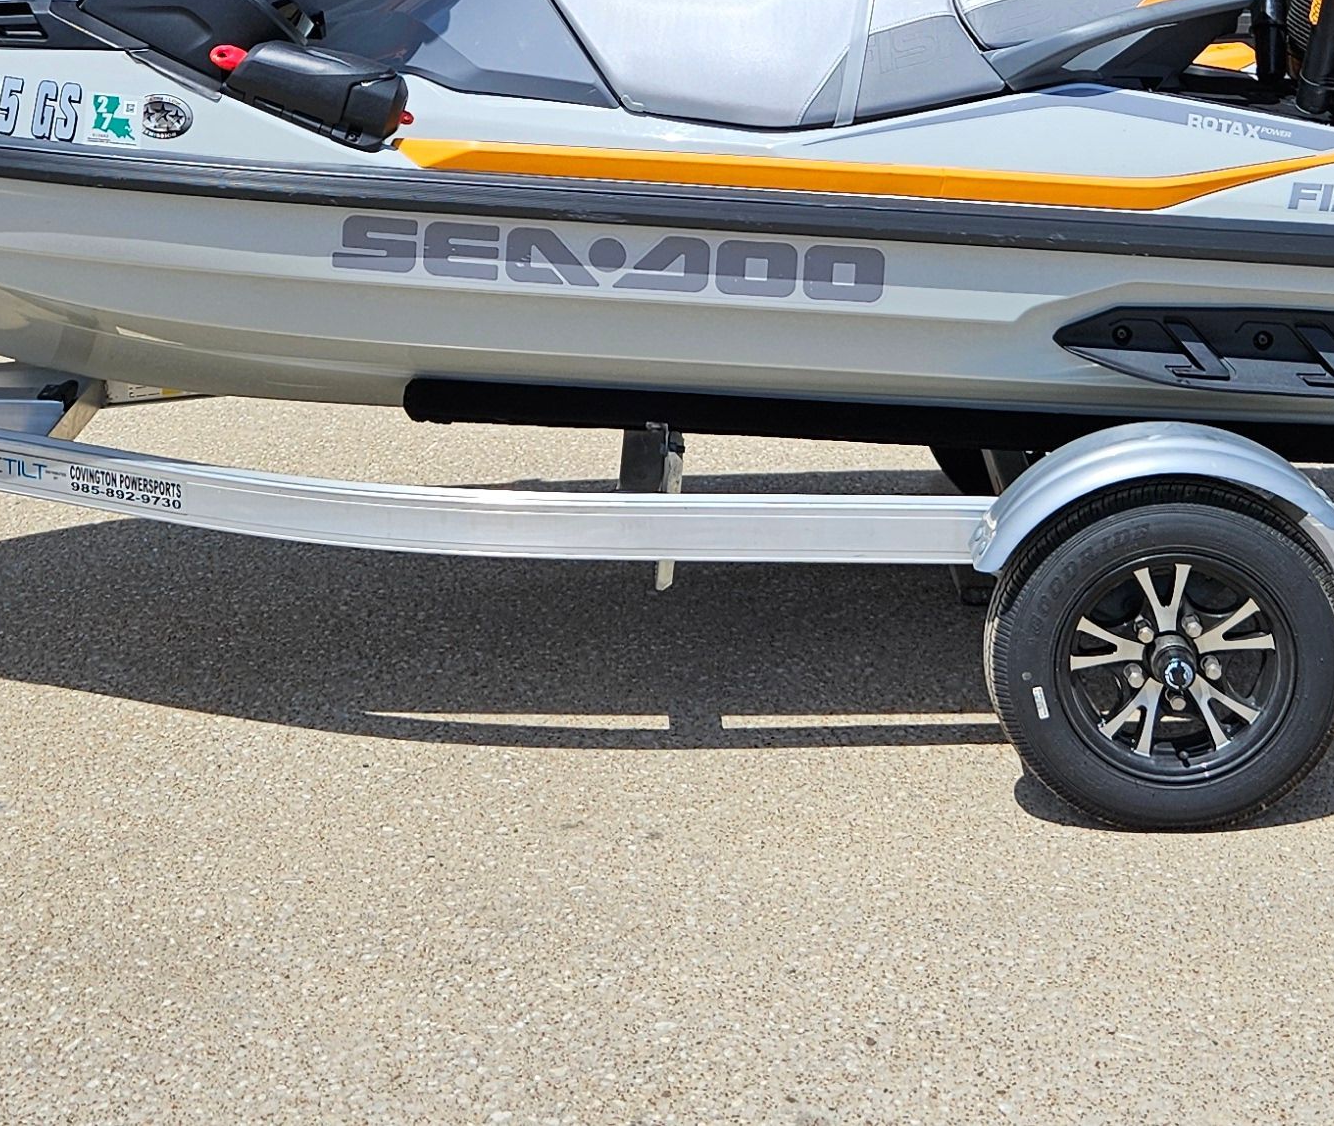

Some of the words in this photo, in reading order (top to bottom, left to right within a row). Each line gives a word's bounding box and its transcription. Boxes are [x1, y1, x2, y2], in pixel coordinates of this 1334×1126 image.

[30, 80, 83, 142] GS
[1188, 113, 1261, 140] ROTAX
[1261, 126, 1292, 138] POWER
[69, 465, 117, 487] COVINGTON
[119, 474, 182, 498] POWERSPORTS
[70, 482, 182, 510] 985-892-9730
